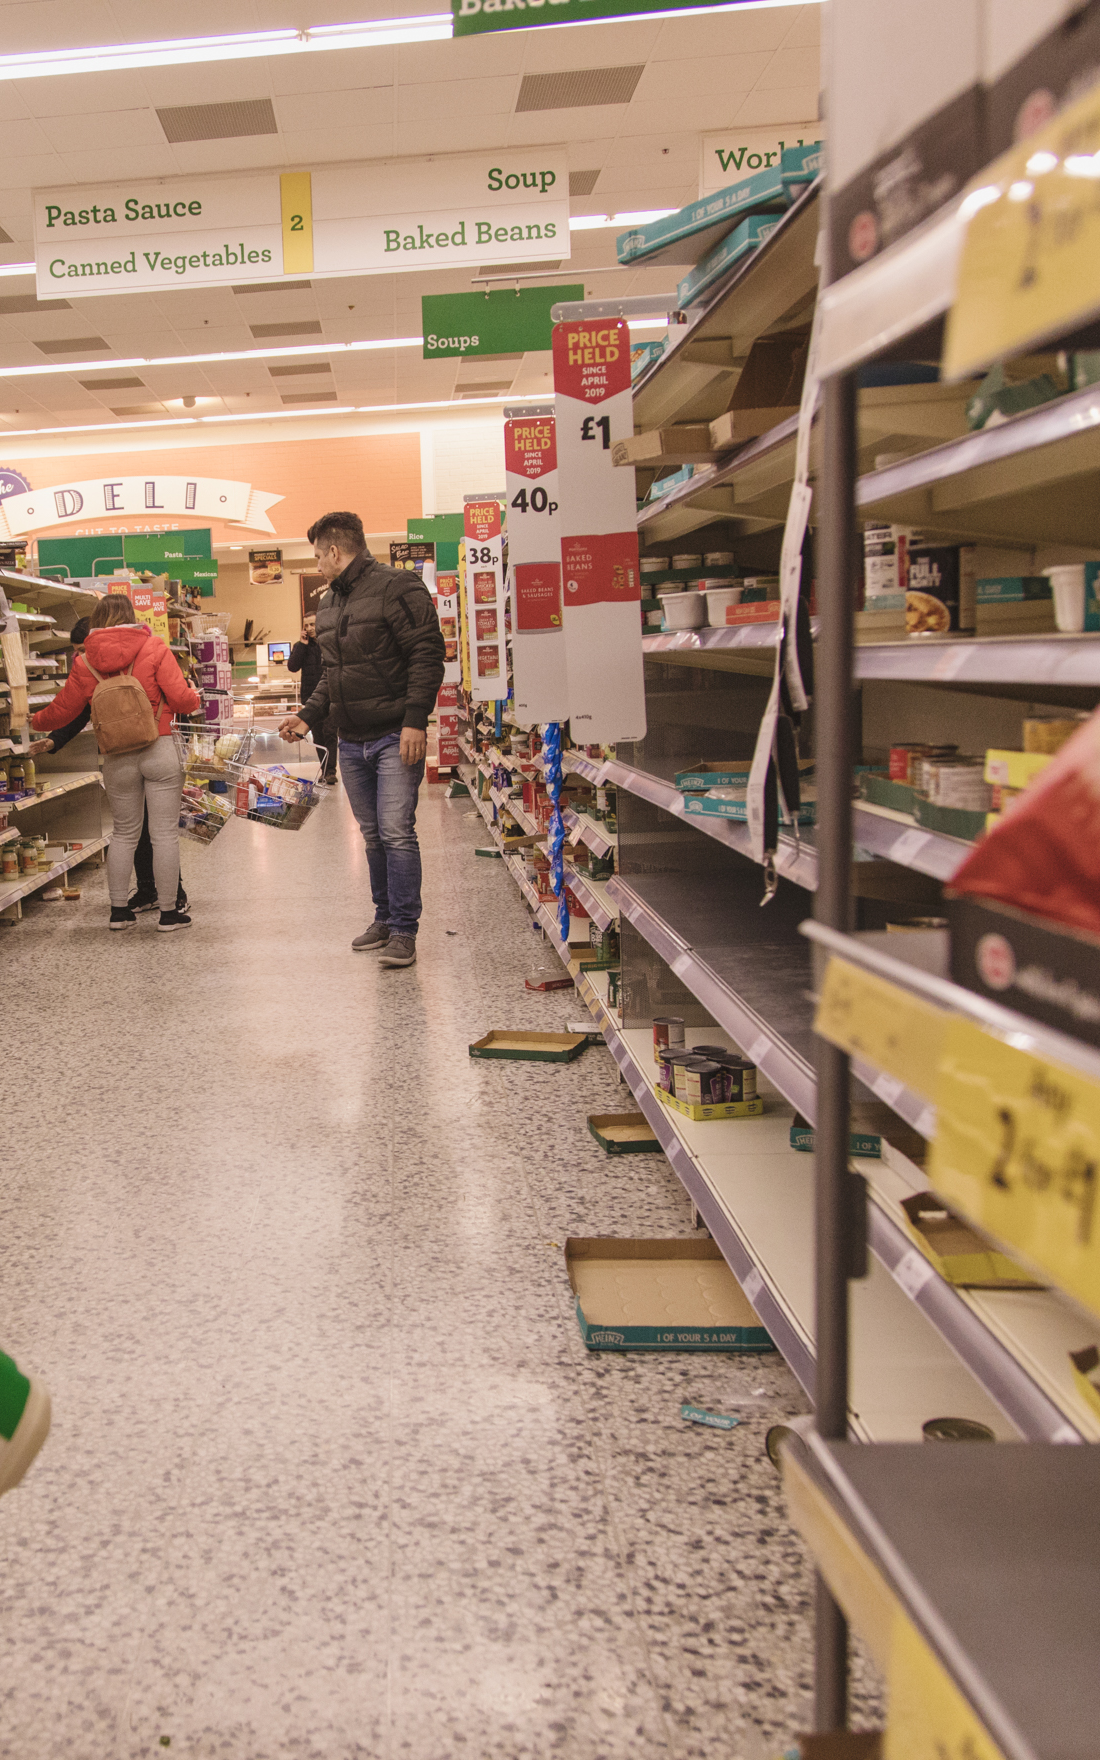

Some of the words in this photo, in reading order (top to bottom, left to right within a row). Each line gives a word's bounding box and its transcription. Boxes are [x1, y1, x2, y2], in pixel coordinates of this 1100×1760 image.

[487, 167, 557, 194] Soup
[45, 202, 117, 228] Pasta
[123, 197, 203, 222] Sauce
[289, 214, 305, 232] 2
[383, 223, 469, 253] Baked
[475, 220, 557, 245] Beans
[48, 252, 138, 280] Canned
[142, 242, 273, 277] Vegetables
[426, 332, 480, 352] Soups
[567, 329, 620, 349] PRICE
[568, 346, 619, 365] HELD
[582, 365, 607, 375] SINCE
[581, 375, 609, 386] APRIL
[584, 388, 605, 398] 2019
[514, 426, 551, 439] PRICE
[580, 416, 611, 450] £1
[514, 437, 551, 451] HELD
[523, 458, 543, 466] APRIL
[526, 467, 541, 475] 2019
[53, 481, 197, 518] DELI
[511, 486, 559, 516] 40p
[469, 507, 494, 517] PRICE
[470, 515, 494, 524] HELD
[469, 547, 499, 566] 38p
[566, 554, 592, 563] BAKED
[567, 563, 593, 571] BEANS
[681, 779, 703, 787] HEINZ
[595, 1333, 621, 1344] HEINZ
[663, 1334, 675, 1342] OF
[677, 1334, 701, 1342] YOUR
[704, 1334, 710, 1342] 5
[711, 1334, 719, 1342] A
[720, 1334, 737, 1342] DAY
